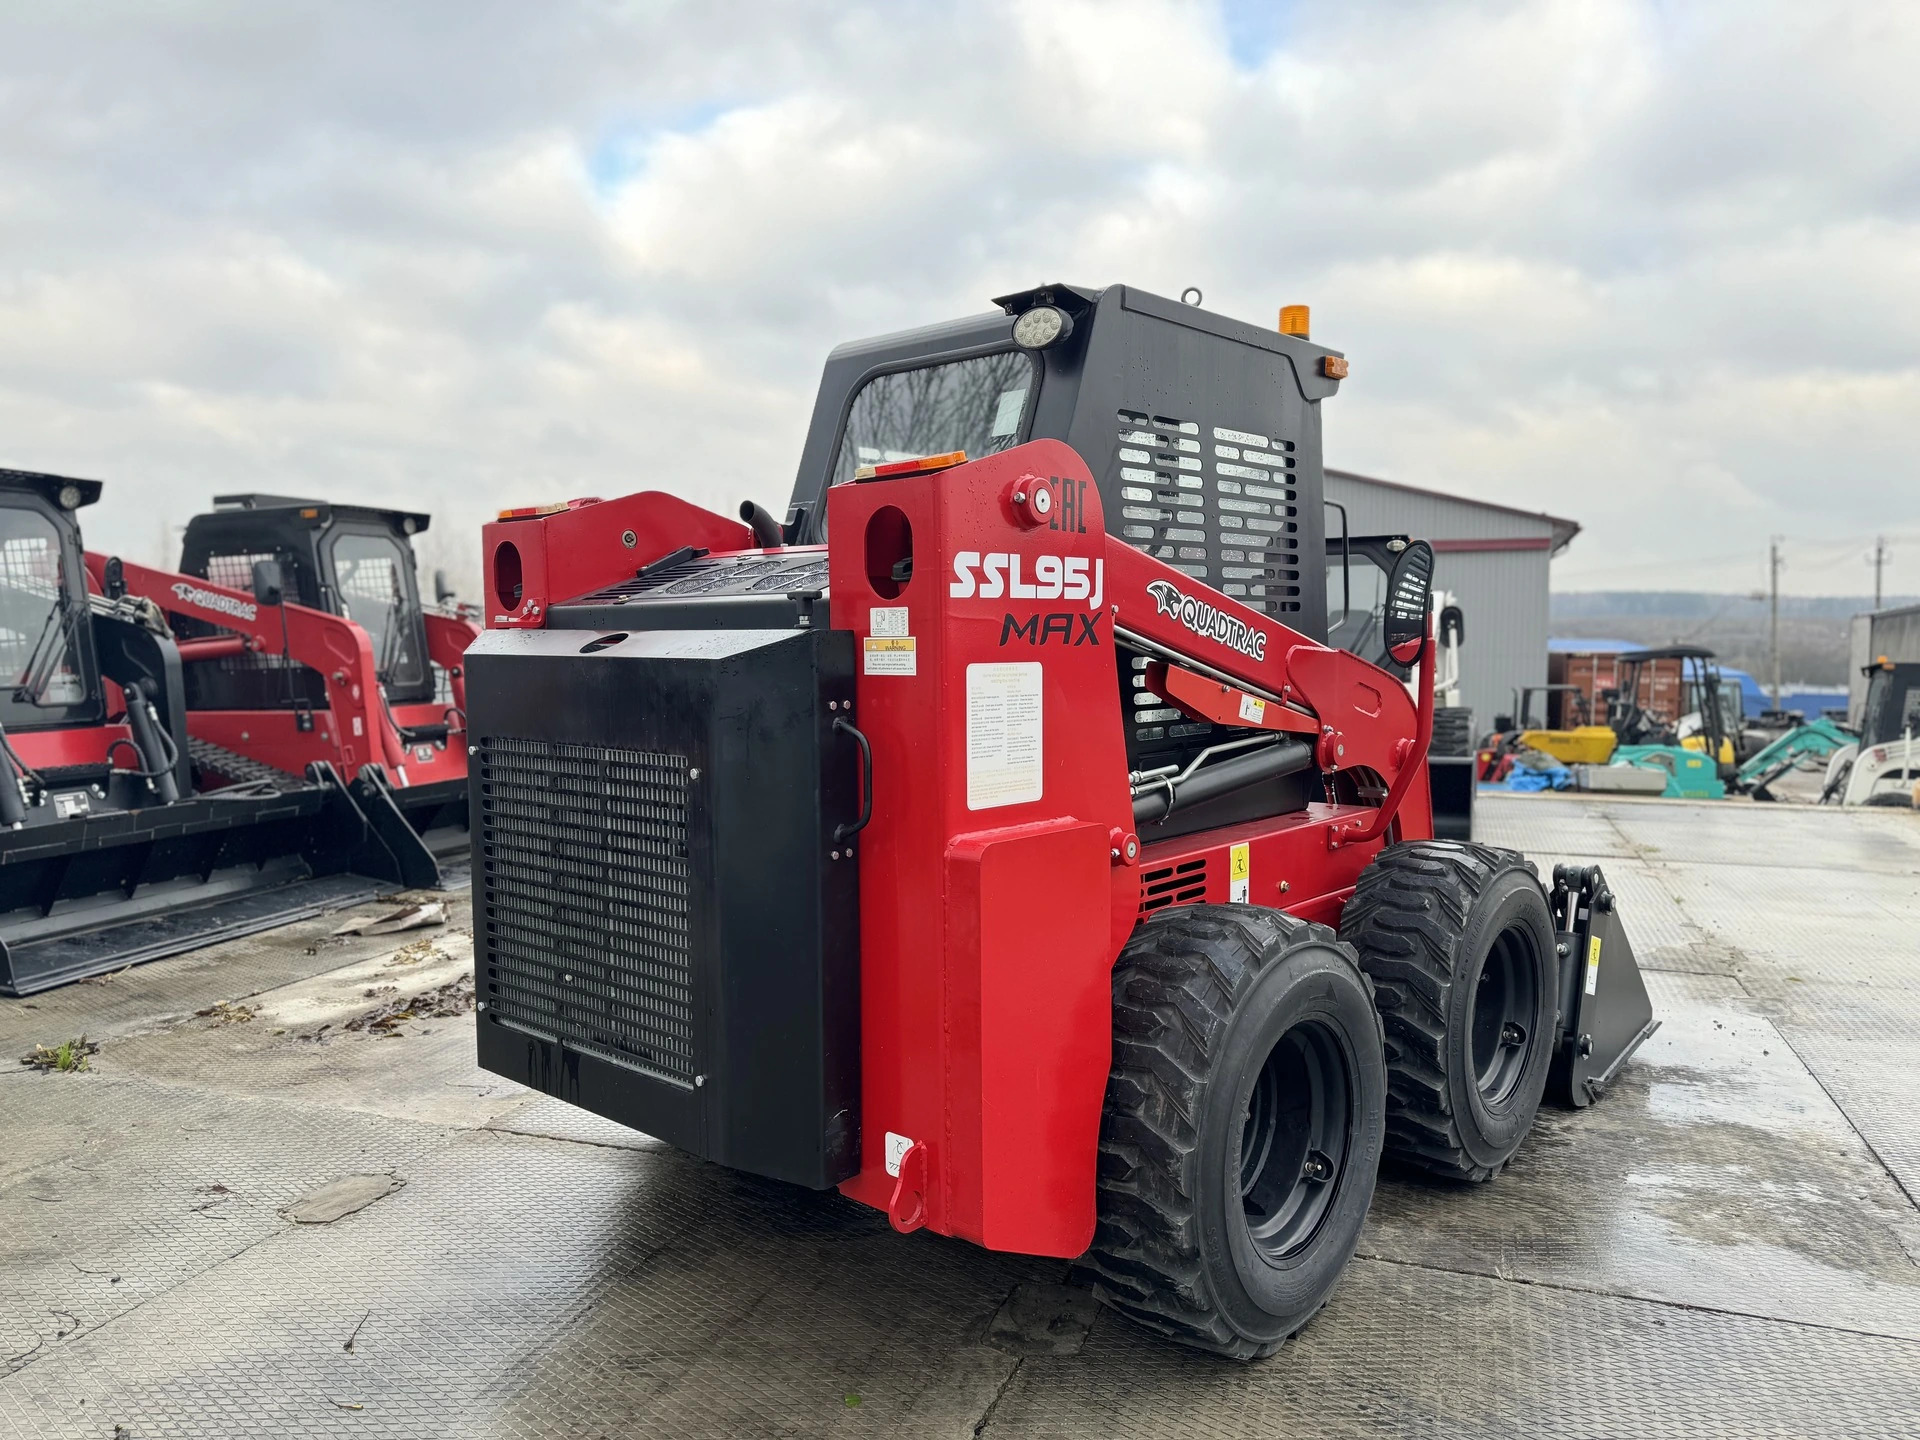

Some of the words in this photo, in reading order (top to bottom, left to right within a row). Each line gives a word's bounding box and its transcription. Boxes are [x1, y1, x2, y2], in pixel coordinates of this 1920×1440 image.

[950, 551, 1104, 610] SSL95J
[193, 588, 257, 621] QUADTRAC
[999, 611, 1103, 647] MAX
[1181, 595, 1267, 662] QUADTRAC
